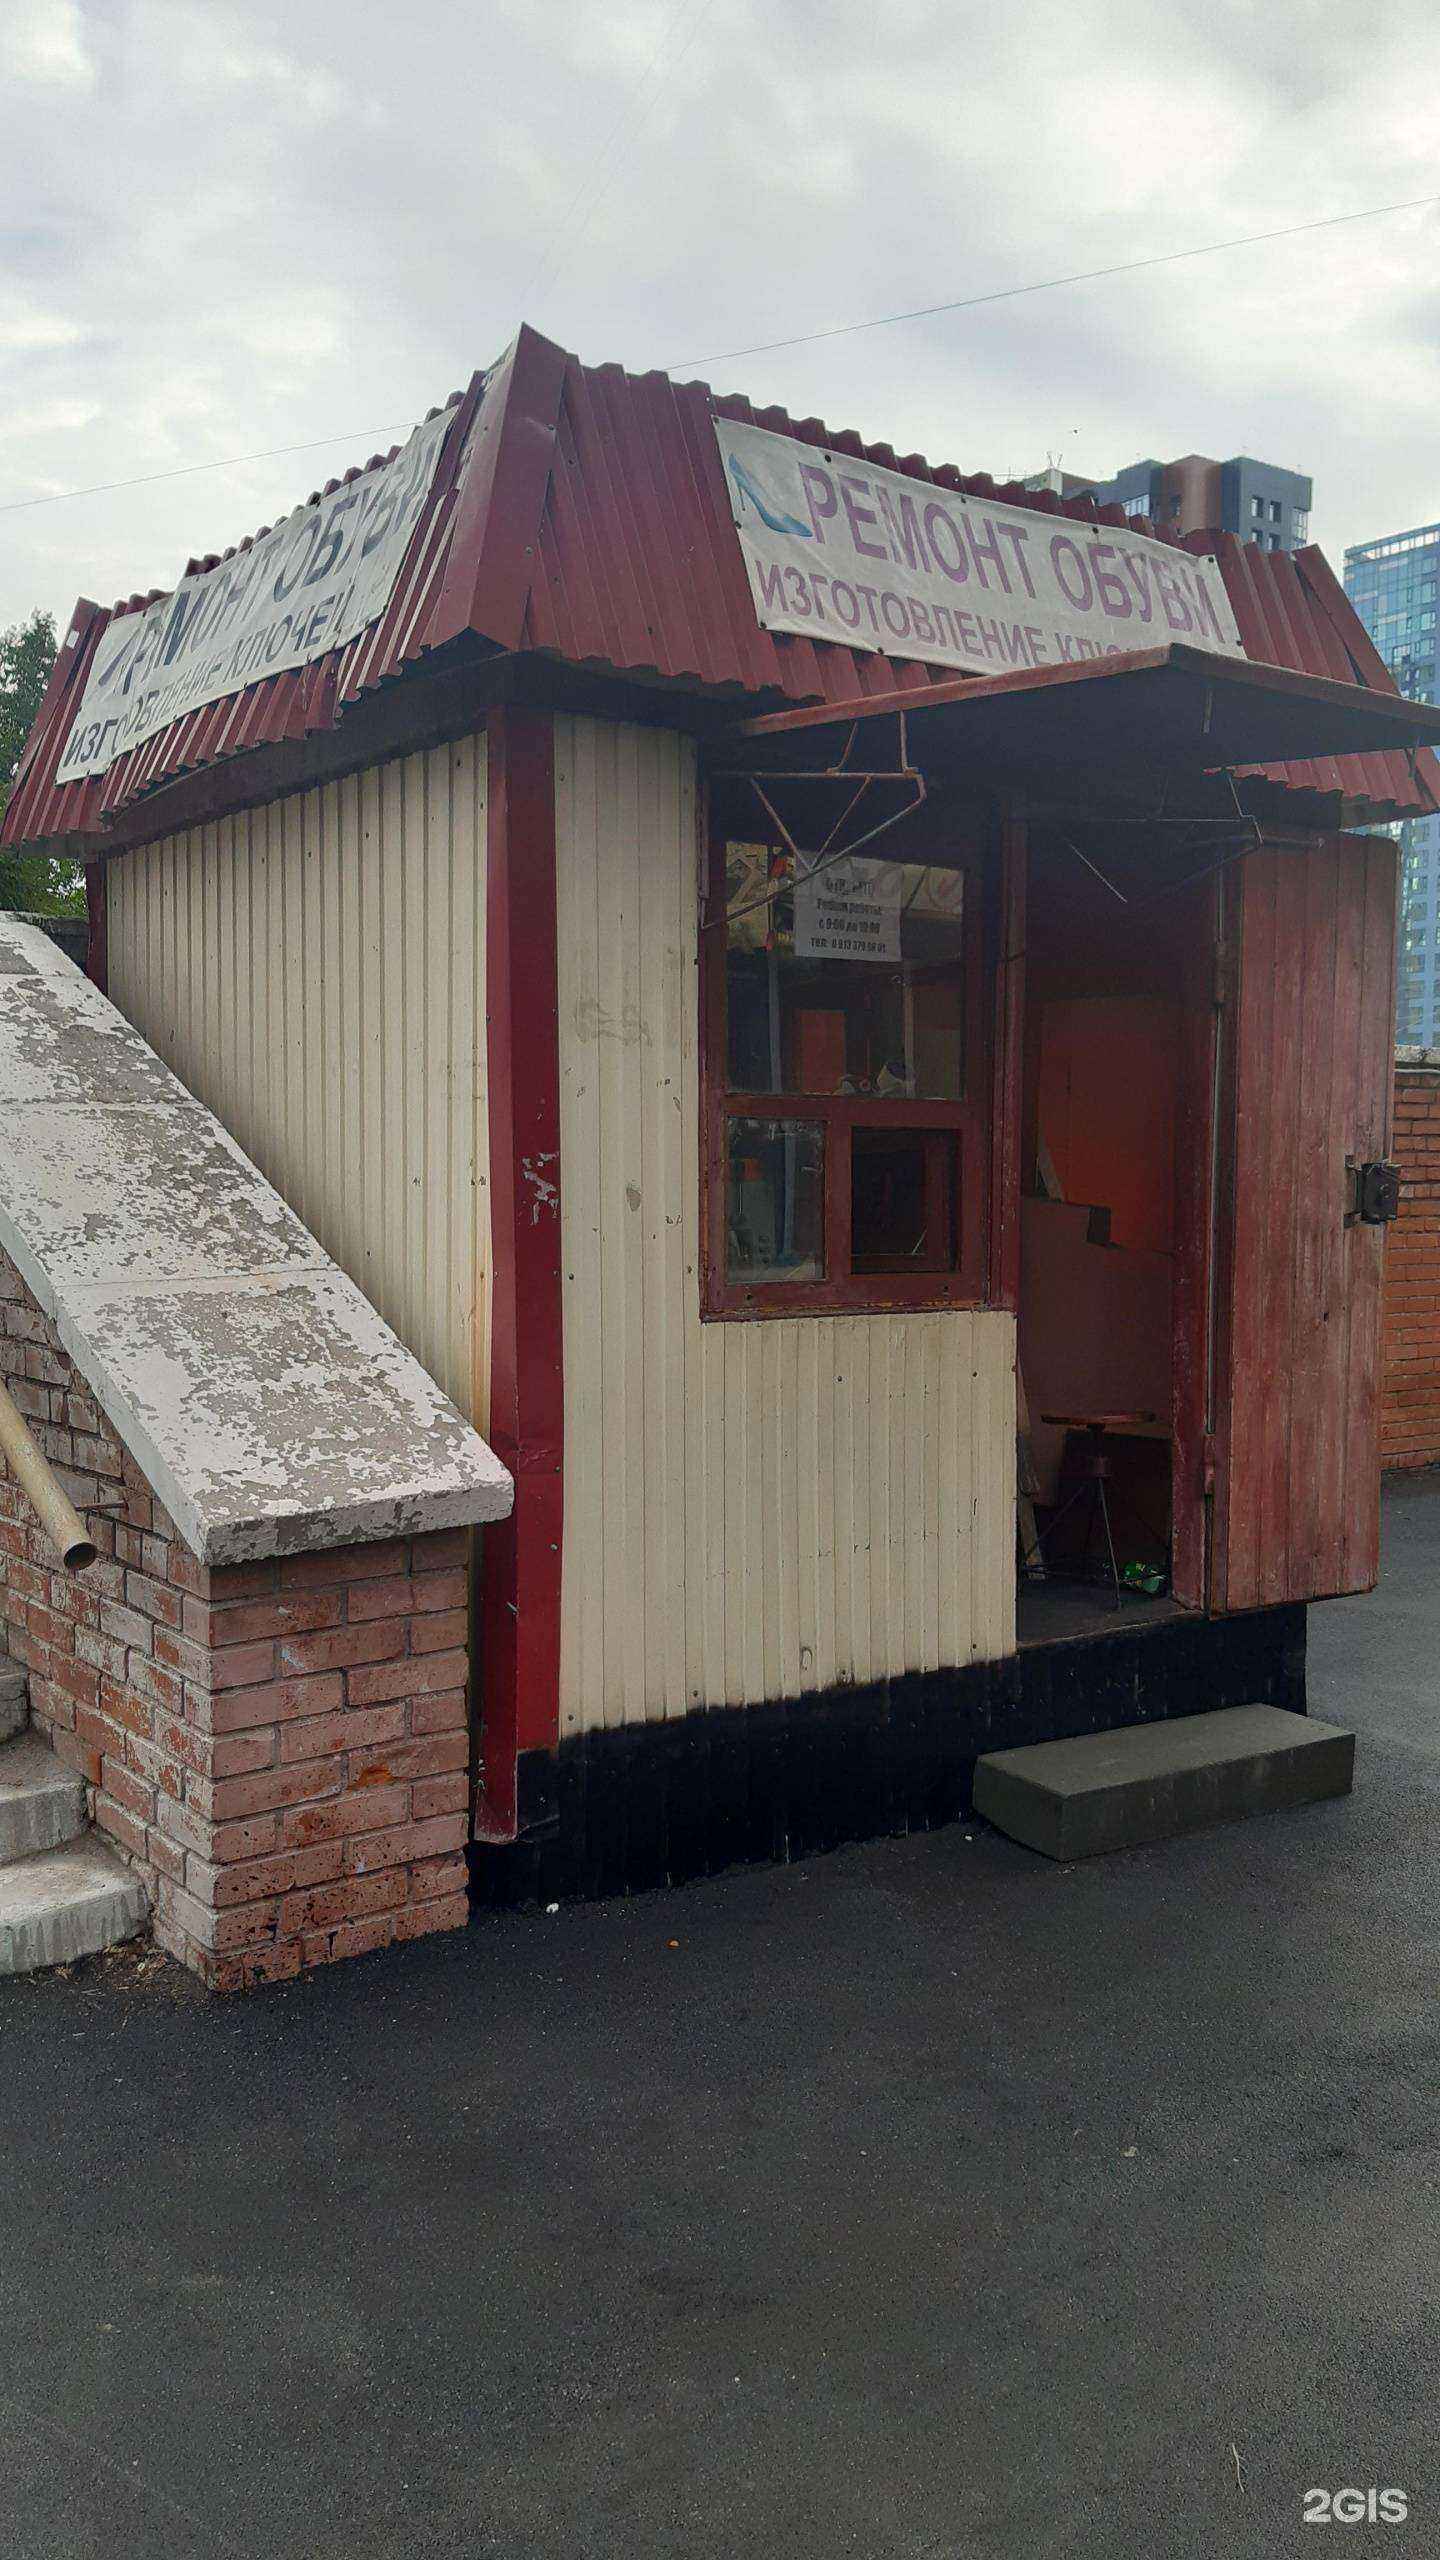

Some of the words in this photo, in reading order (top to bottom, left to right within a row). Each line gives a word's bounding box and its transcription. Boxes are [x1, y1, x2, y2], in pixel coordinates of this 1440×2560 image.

[122, 533, 285, 695] РМОНТ
[755, 559, 1047, 666] ИЗГОТОВЛЕНИЕ
[798, 461, 1037, 600] РЕМОНТ
[1048, 534, 1226, 645] ОБУВИ
[63, 655, 223, 768] ИЗГООВЛЕНИЕ
